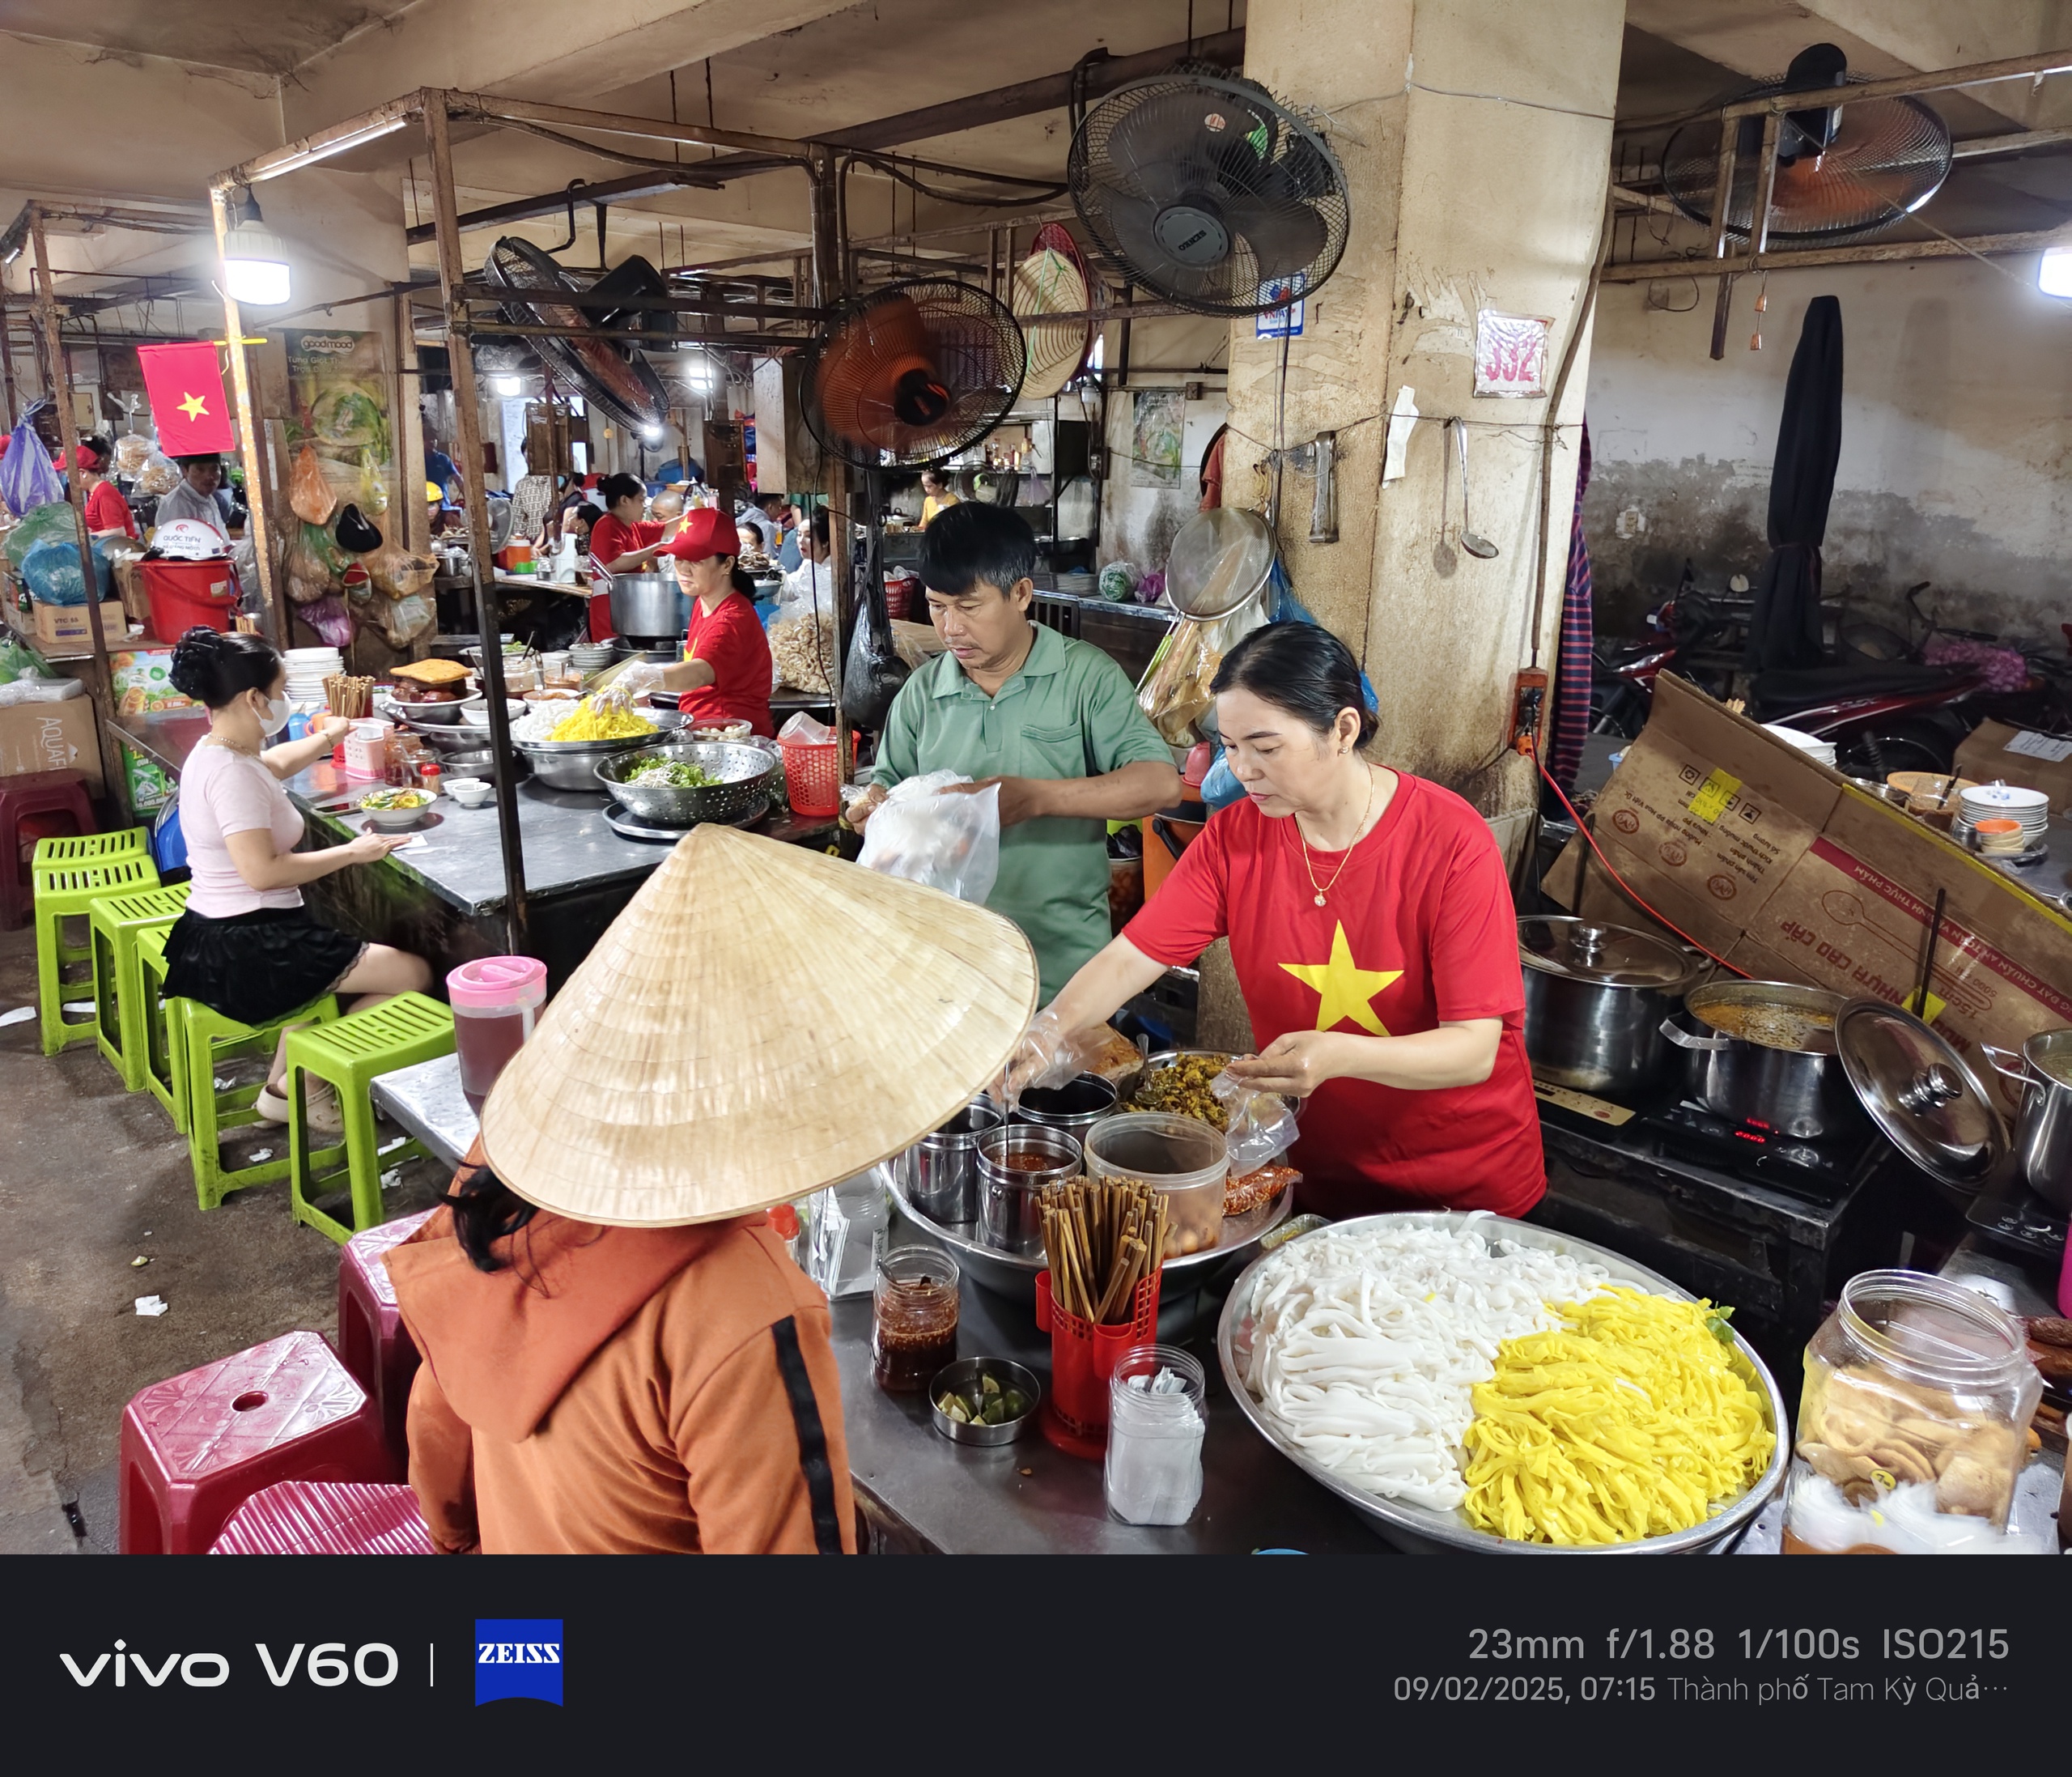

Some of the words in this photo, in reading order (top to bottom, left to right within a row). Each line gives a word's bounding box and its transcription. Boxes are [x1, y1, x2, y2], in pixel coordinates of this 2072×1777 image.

[1178, 230, 1207, 251] SENKO
[1781, 920, 1817, 946] CẤP
[1815, 942, 1853, 971] CAO
[1938, 988, 1978, 1020] 15cm
